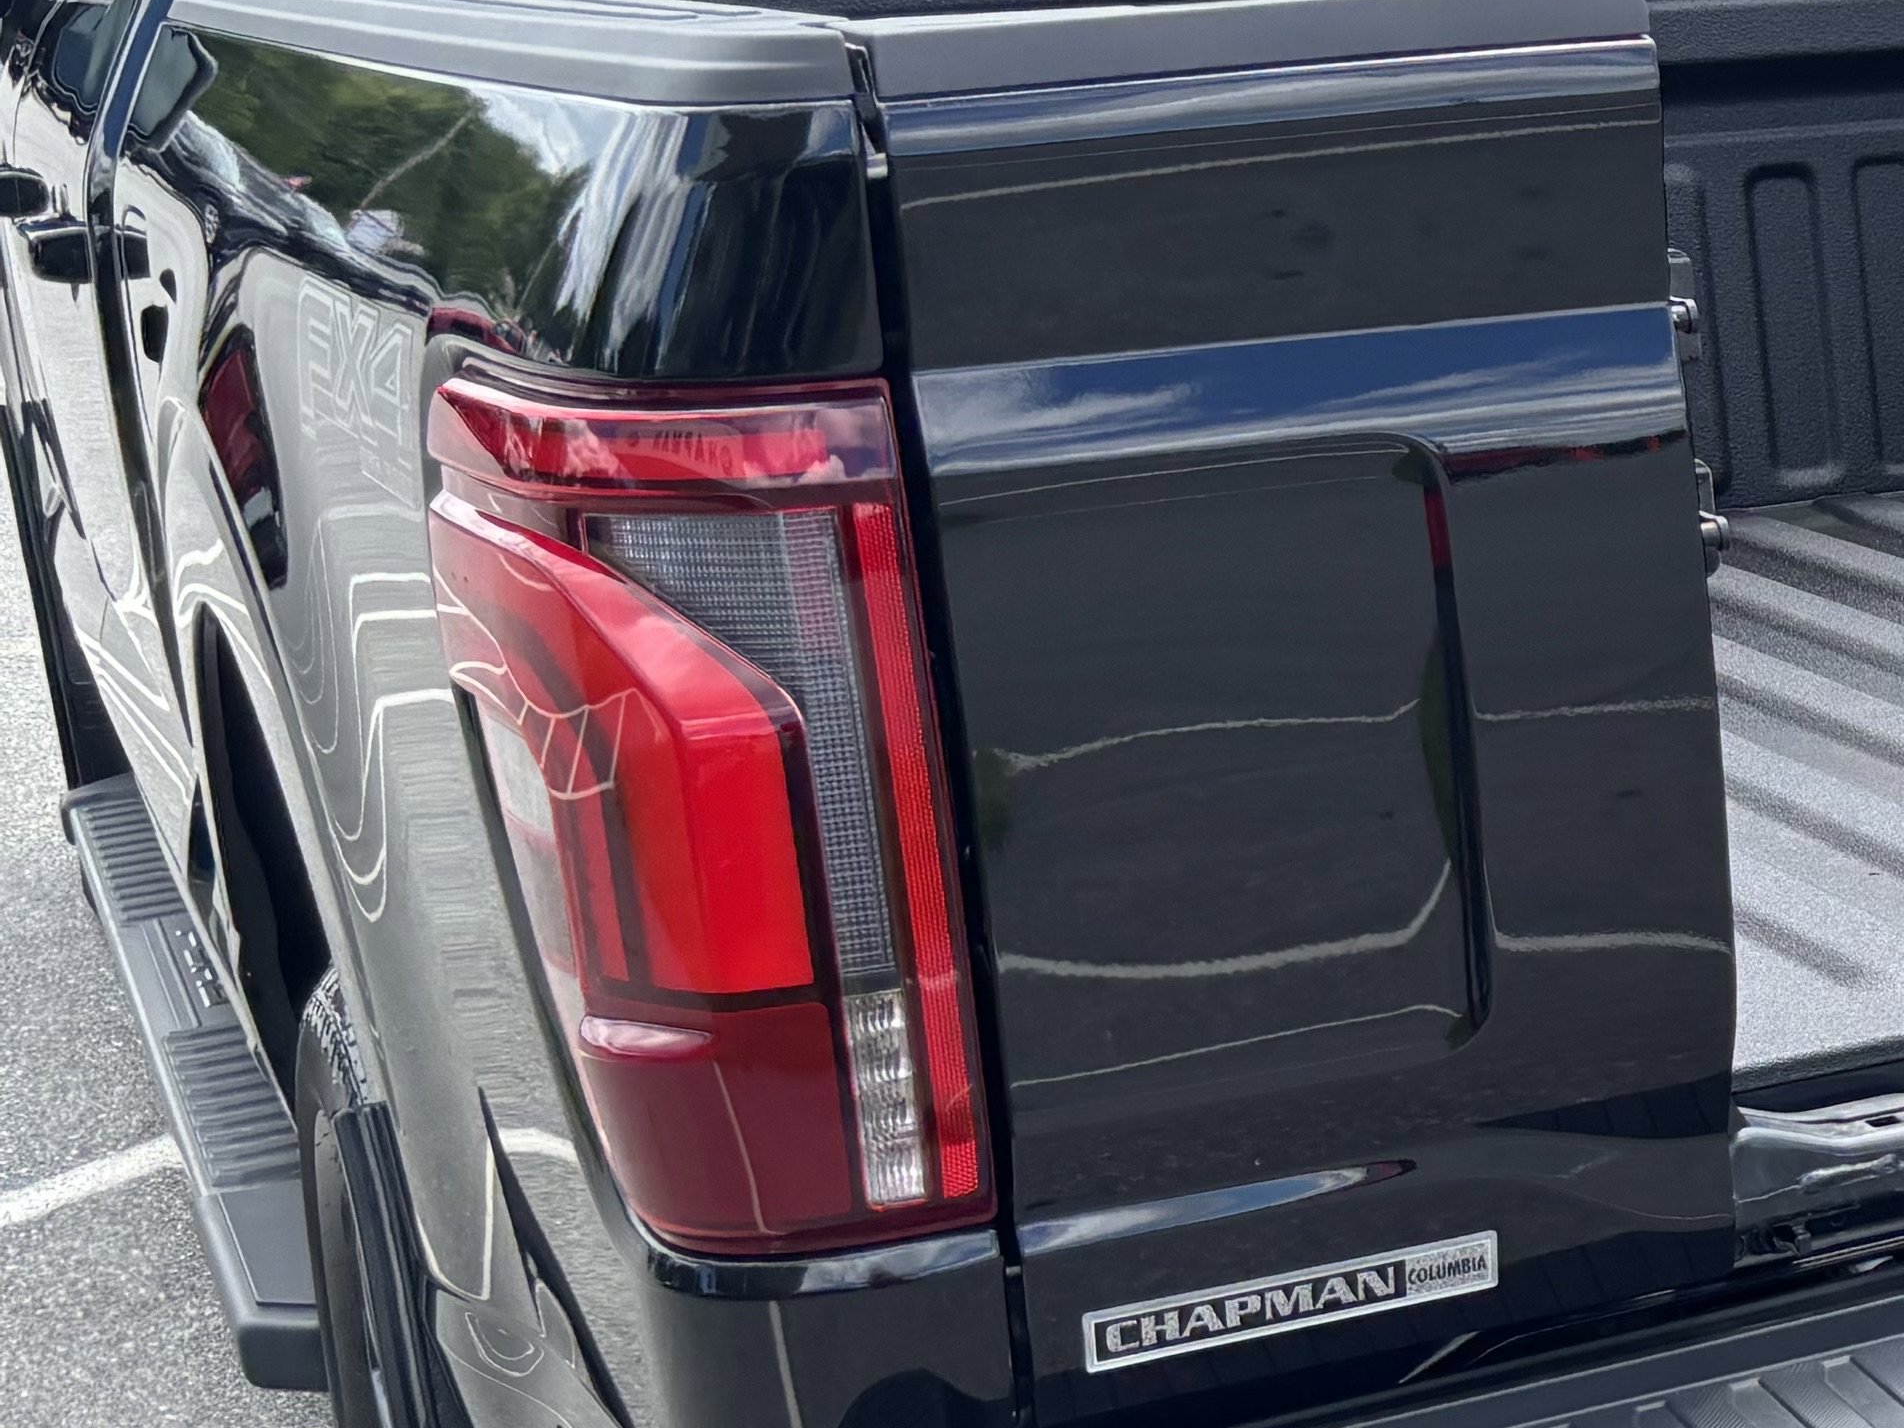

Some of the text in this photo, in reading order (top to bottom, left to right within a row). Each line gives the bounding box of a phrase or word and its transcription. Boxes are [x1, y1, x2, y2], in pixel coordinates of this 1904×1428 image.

[298, 274, 413, 450] FX4
[1105, 1253, 1487, 1353] CHAPMAN COLUMBIA
